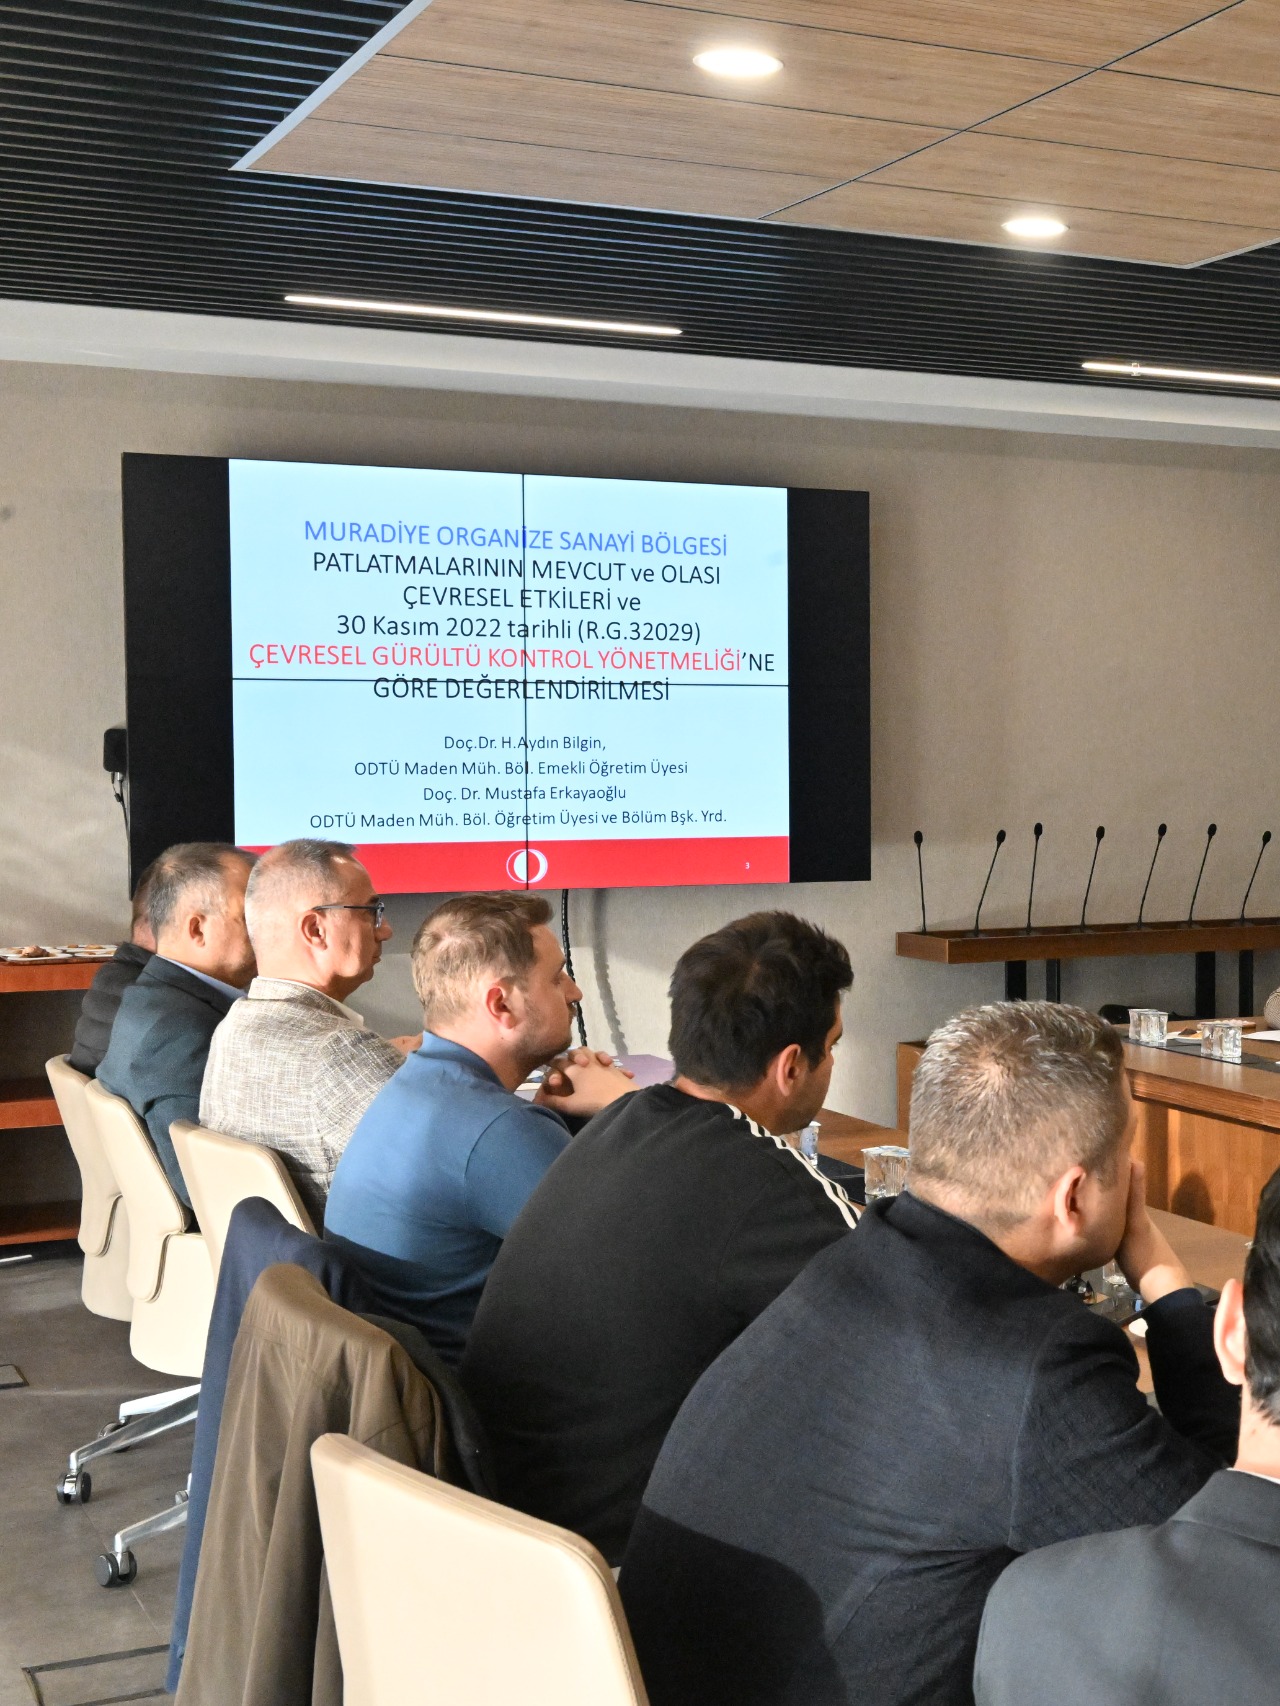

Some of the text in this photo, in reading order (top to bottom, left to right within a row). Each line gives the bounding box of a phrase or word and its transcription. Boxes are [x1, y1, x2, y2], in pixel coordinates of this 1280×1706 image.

[305, 520, 727, 556] MURADİYE ORGANİZE SANAYİ BÖLGESİ
[313, 552, 720, 585] PATLATMALARININ MEVCUT ve OLASI
[403, 585, 641, 611] ÇEVRESEL ETKİLERİ ve
[337, 615, 701, 646] 30 Kasım 2022 tarihli (R.G.32029)
[249, 643, 367, 669] ÇEVRESEL
[372, 642, 481, 667] GÜRÜLTÜ
[489, 648, 593, 669] KONTROL
[373, 673, 669, 701] GÖRE DEĞERLENDİRİLMESİ
[444, 735, 606, 752] Doç.Dr. H.Aydın Bilgin,
[354, 758, 688, 777] ODTÜ Maden Müh. Böl. Emekli Öğretim Üyesi
[423, 785, 626, 803] Doç. Dr. Mustafa Erkayaoğlu
[310, 809, 727, 828] ODTÜ Maden Müh. Böl. Öğretim Üyesi ve Bölüm Bşk. Yrd.
[745, 861, 750, 870] 3
